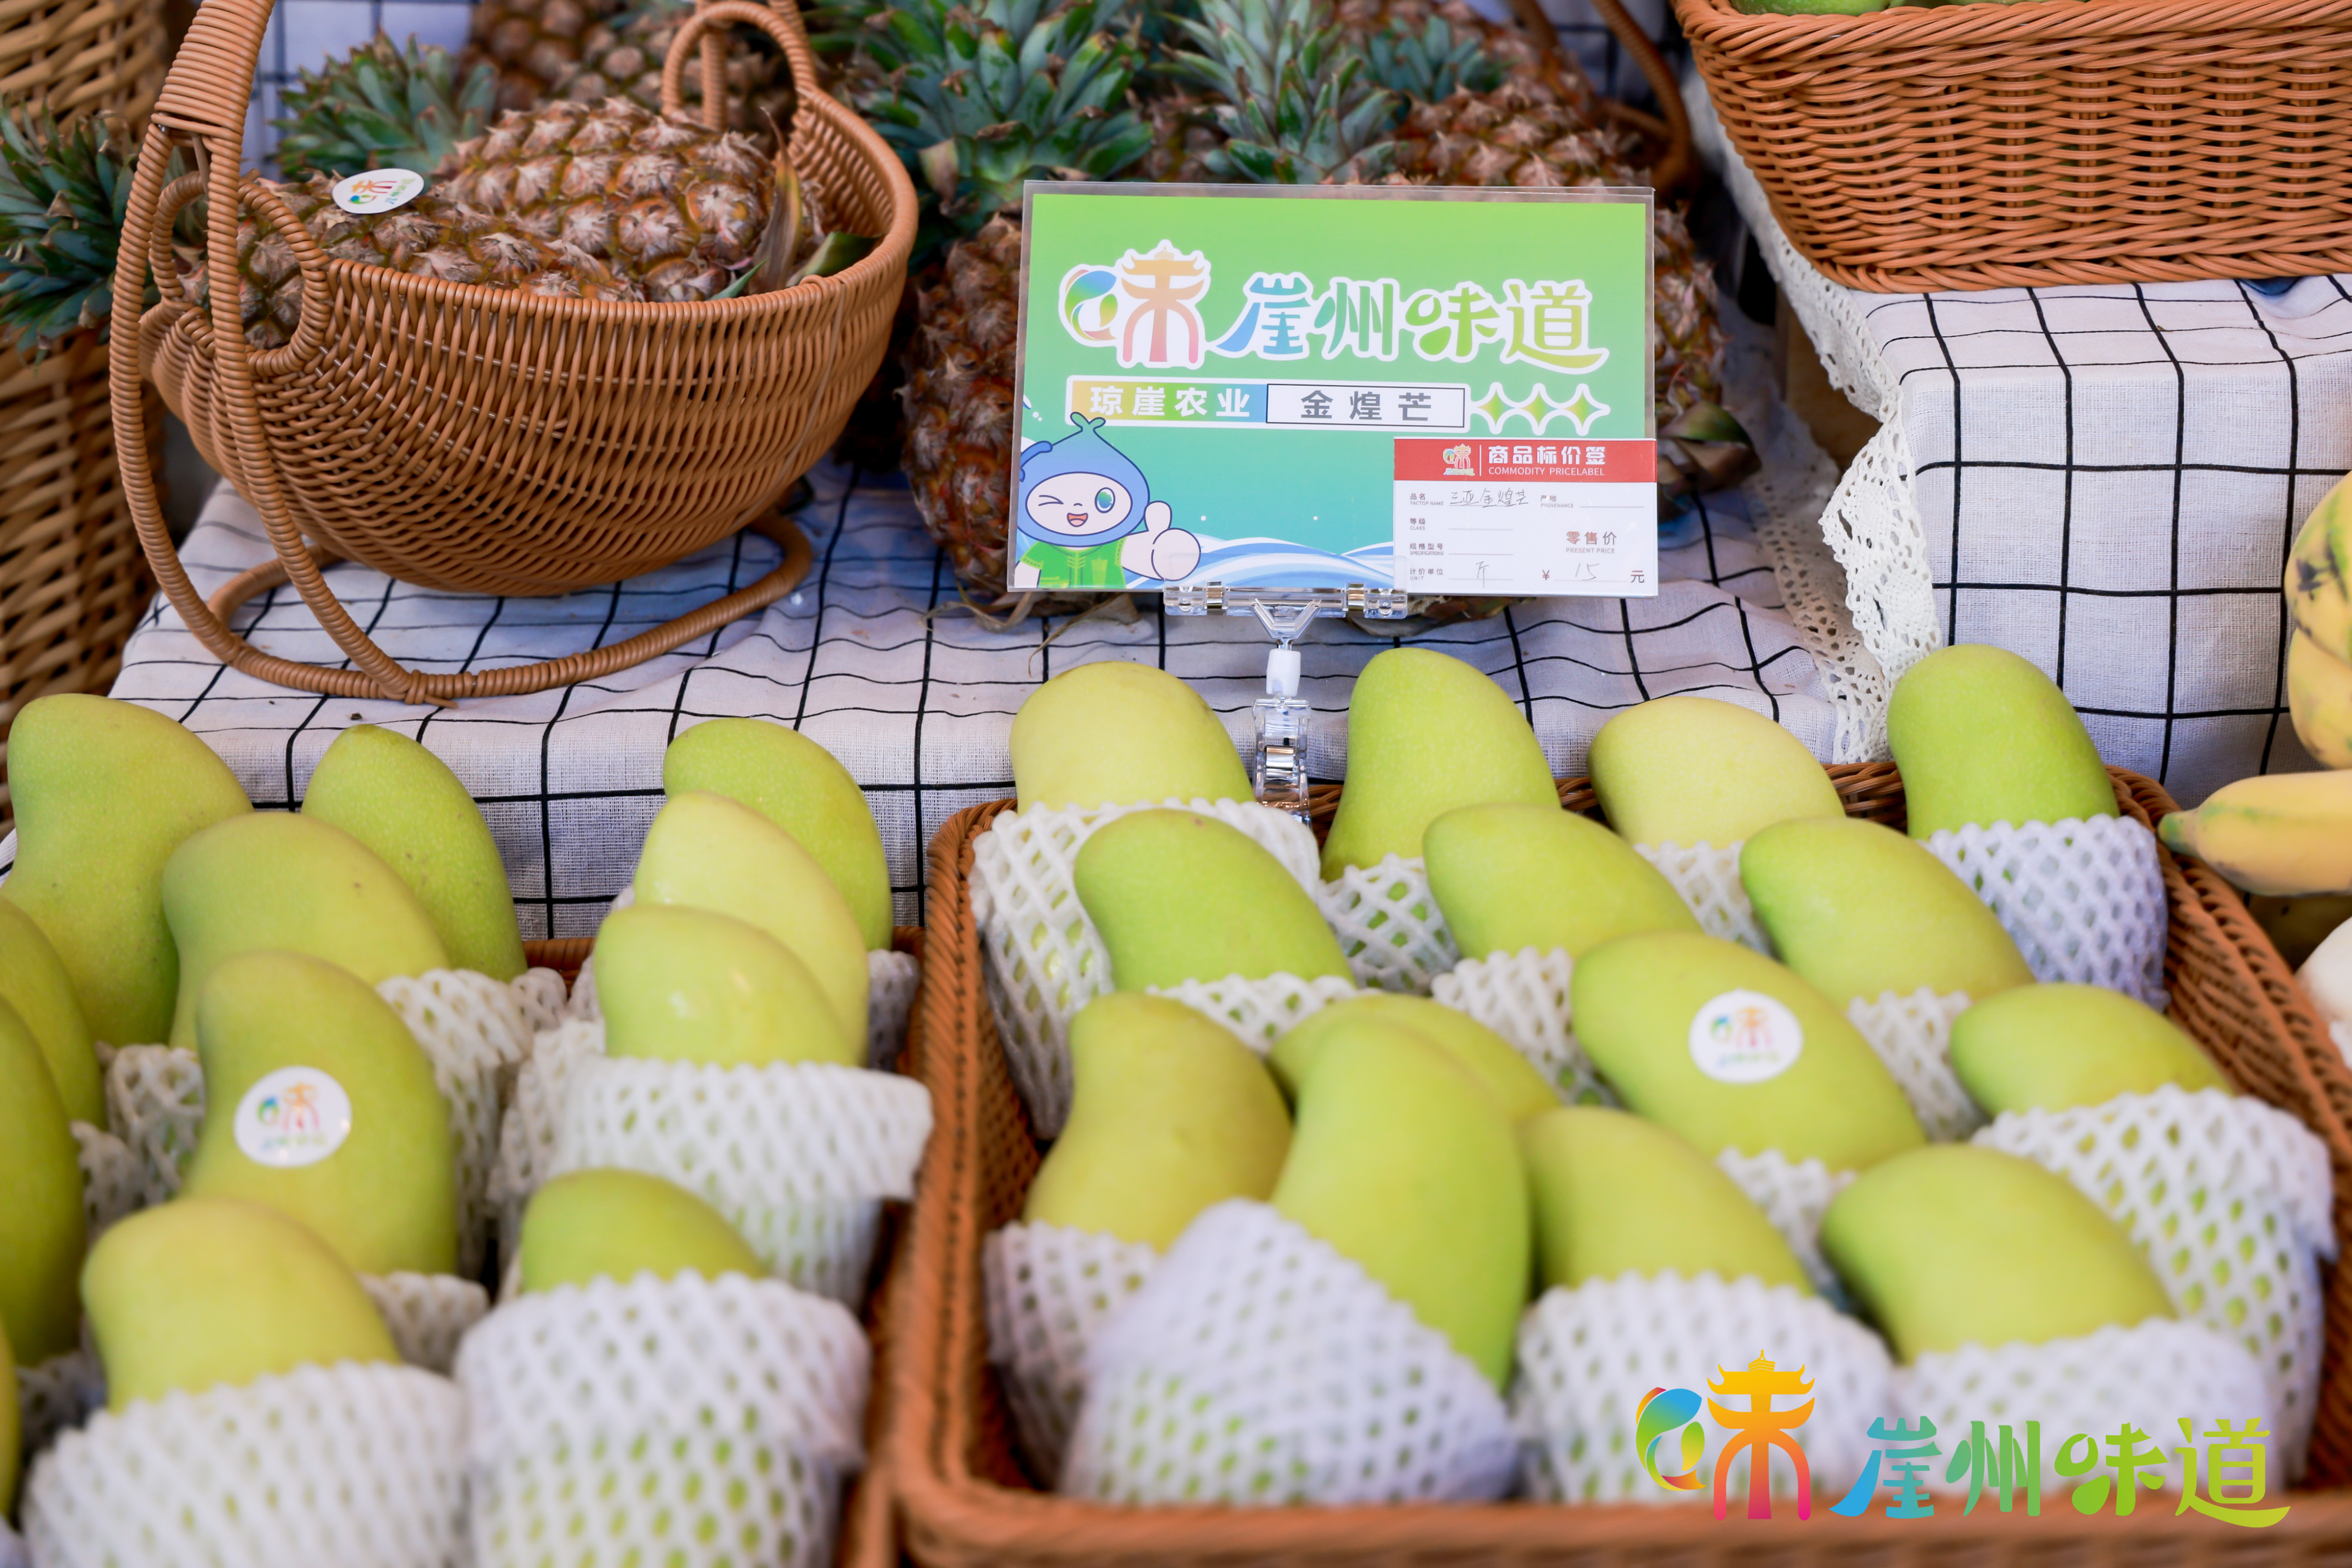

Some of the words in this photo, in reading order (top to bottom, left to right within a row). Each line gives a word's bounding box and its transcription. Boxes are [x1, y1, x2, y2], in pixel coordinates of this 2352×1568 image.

[1215, 275, 1608, 369] 崖州味道
[1090, 386, 1250, 417] 琼崖农业
[1300, 390, 1432, 422] 金煌芒
[1488, 445, 1606, 465] 商品标价签
[1488, 467, 1545, 476] COMMODITY
[1549, 467, 1605, 476] PRICELABEL
[1566, 531, 1617, 546] 零售价
[1575, 563, 1600, 581] 15
[1630, 570, 1645, 583] 元
